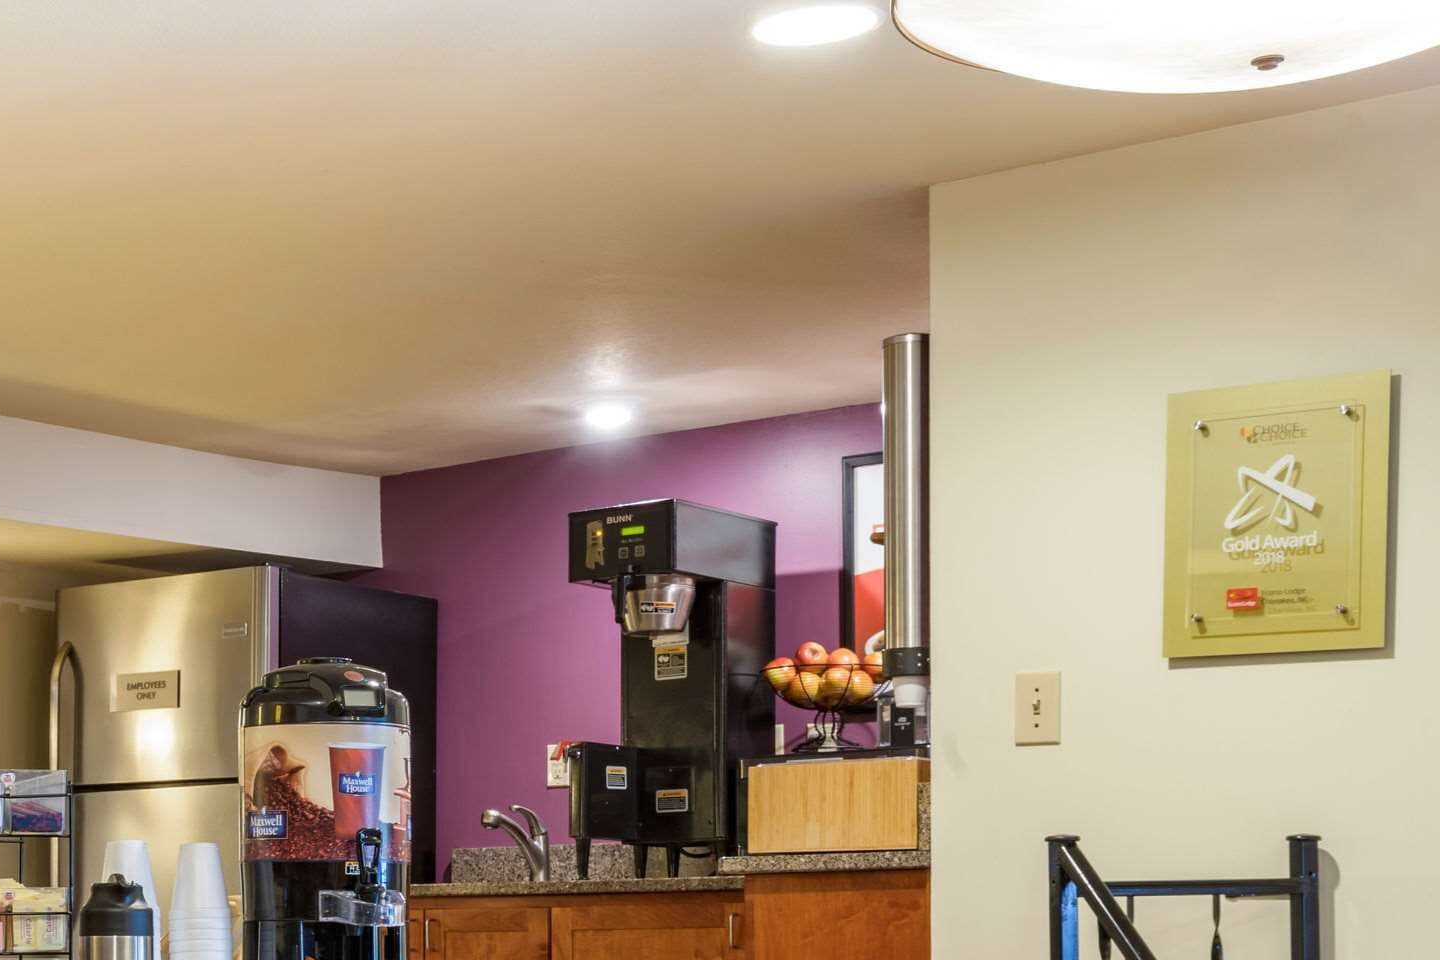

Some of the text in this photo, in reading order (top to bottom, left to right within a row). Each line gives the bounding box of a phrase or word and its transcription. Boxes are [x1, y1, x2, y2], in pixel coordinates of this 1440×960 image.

[606, 514, 632, 524] BUNN
[1222, 530, 1317, 552] Gold Award
[1254, 550, 1286, 565] 2018
[126, 680, 168, 691] EMPLOYEES
[136, 691, 157, 700] ONLY
[342, 775, 373, 786] Maxwell
[346, 784, 369, 793] House
[250, 814, 283, 827] Maxwell
[252, 826, 278, 837] House
